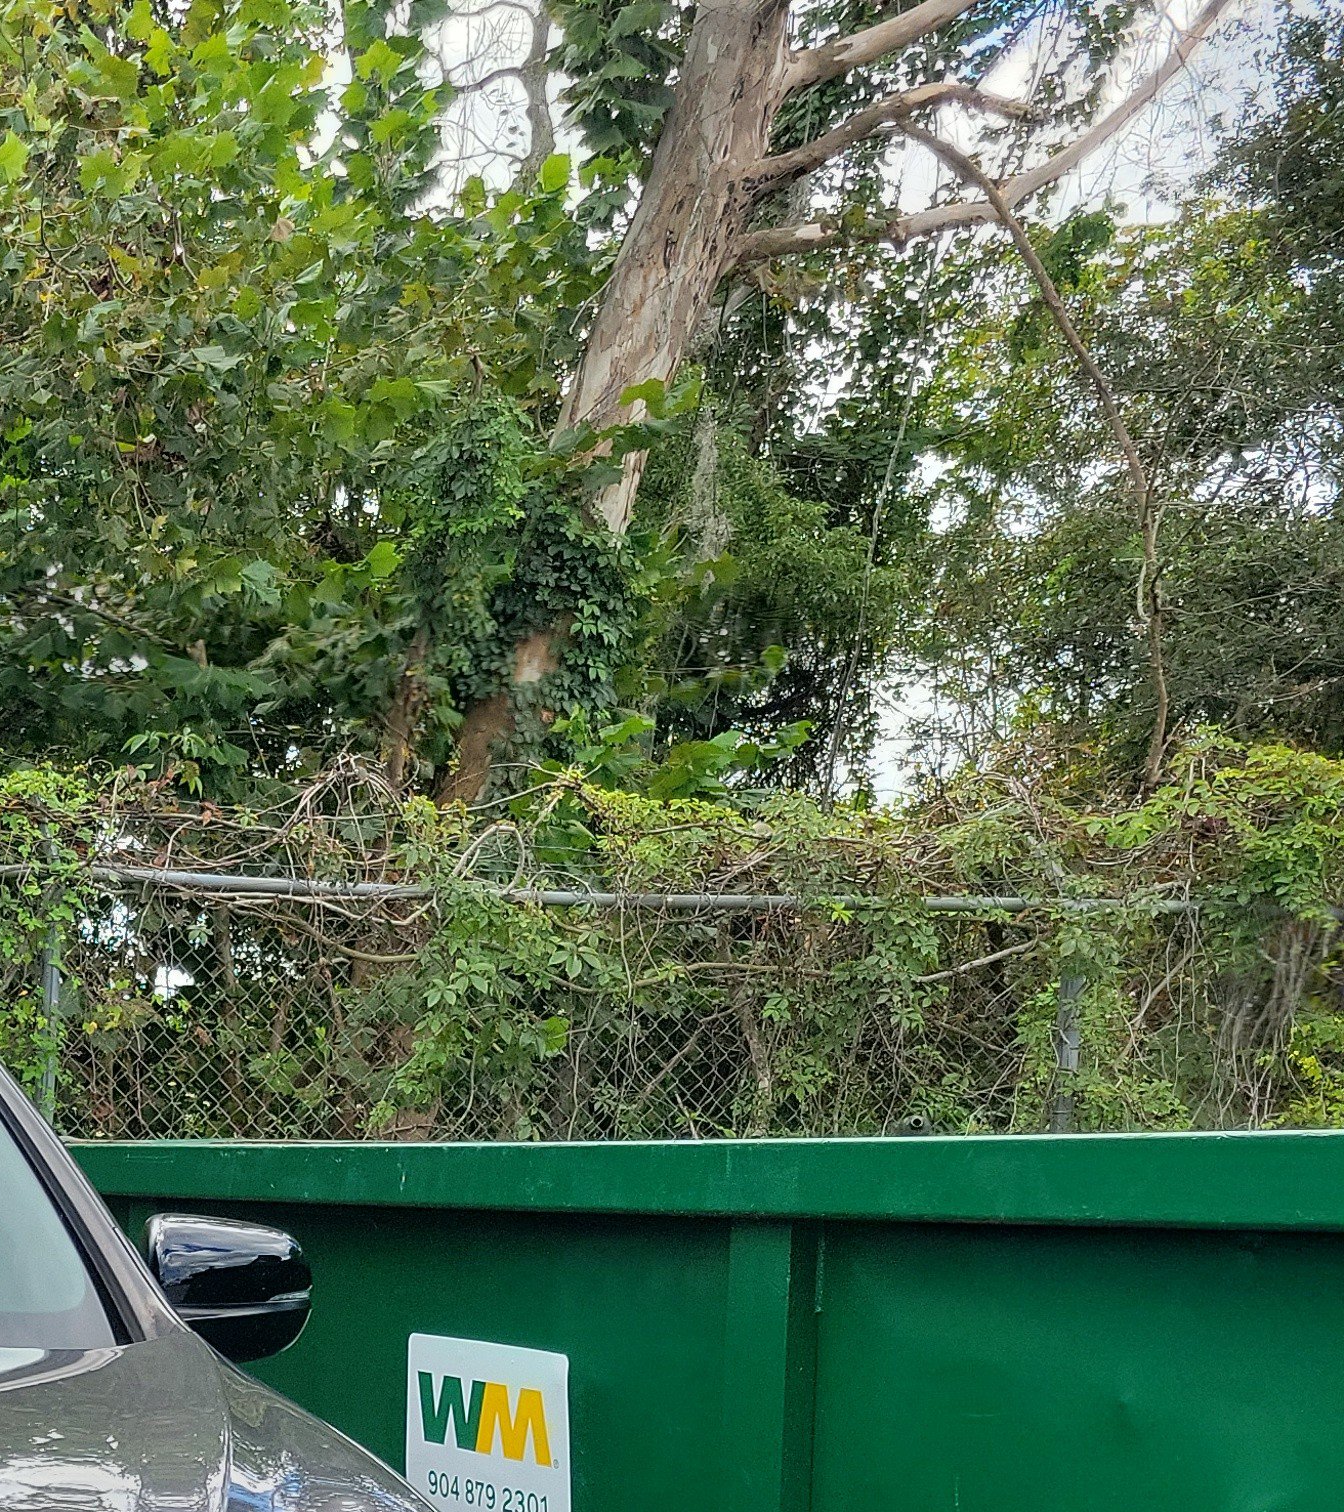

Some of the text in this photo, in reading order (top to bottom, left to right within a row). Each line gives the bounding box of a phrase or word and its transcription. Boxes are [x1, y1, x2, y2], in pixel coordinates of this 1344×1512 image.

[417, 1370, 552, 1468] WM
[428, 1470, 460, 1501] 904
[465, 1479, 496, 1510] 879
